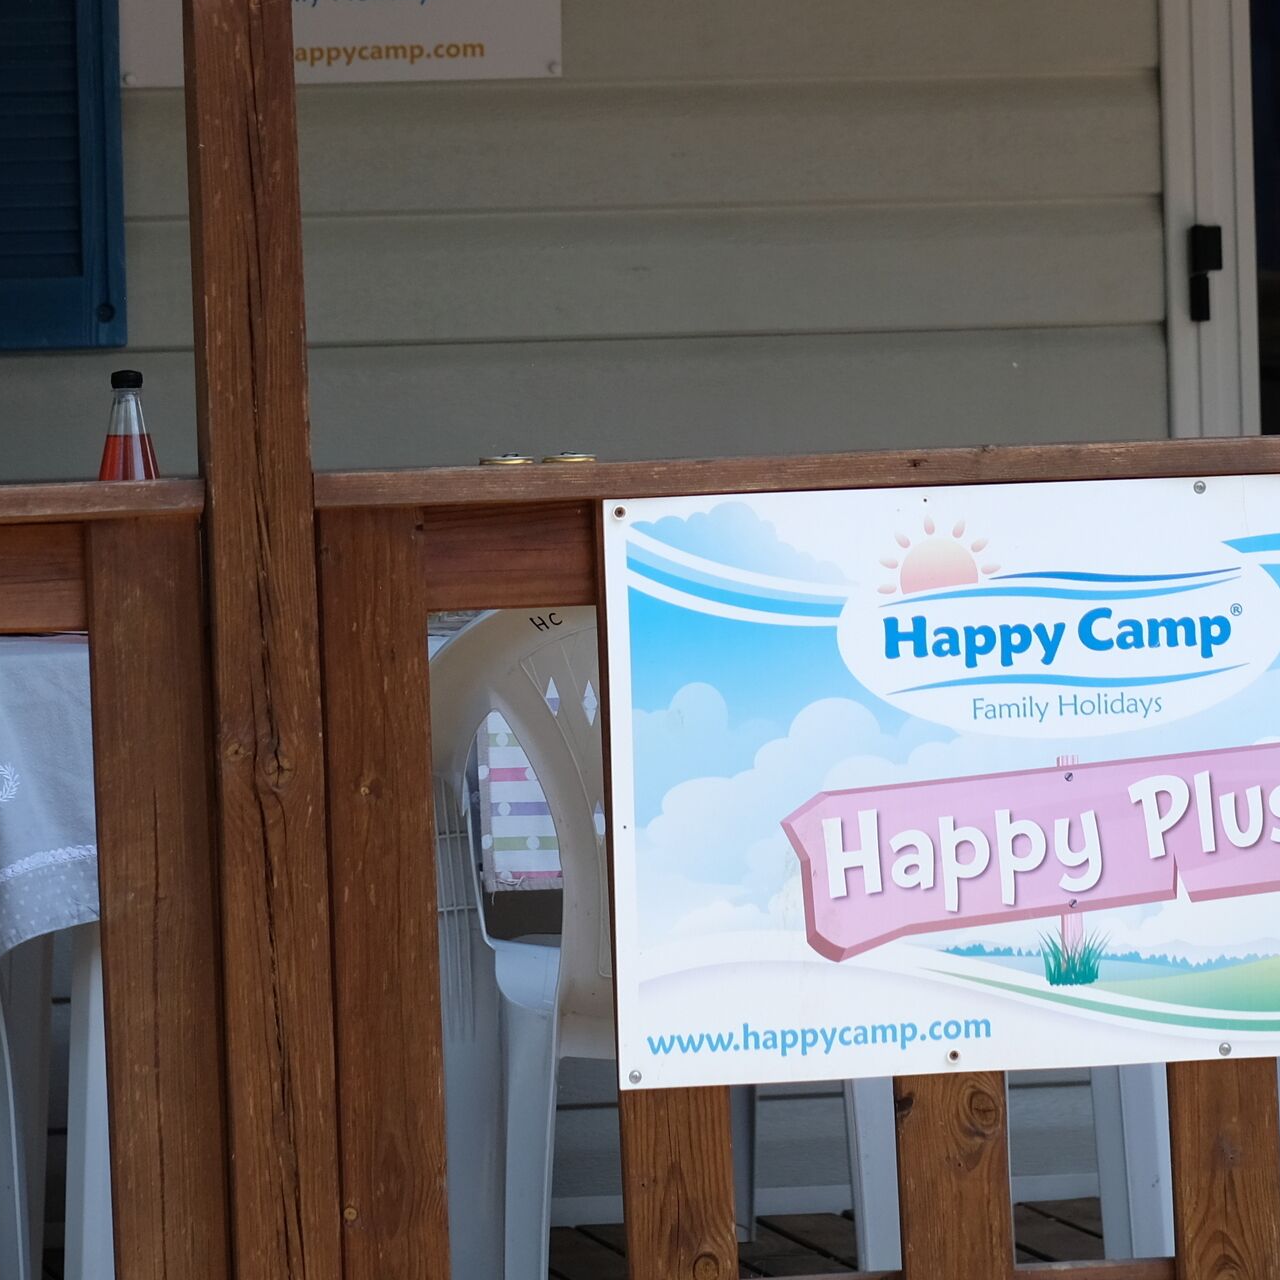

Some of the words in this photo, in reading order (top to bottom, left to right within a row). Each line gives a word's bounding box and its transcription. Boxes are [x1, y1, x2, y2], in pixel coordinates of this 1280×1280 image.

[882, 614, 1066, 669] Happy
[971, 696, 1050, 723] Family
[1058, 691, 1163, 719] Holidays
[821, 808, 1105, 913] Happy
[646, 1017, 993, 1058] www.happycamp.com
